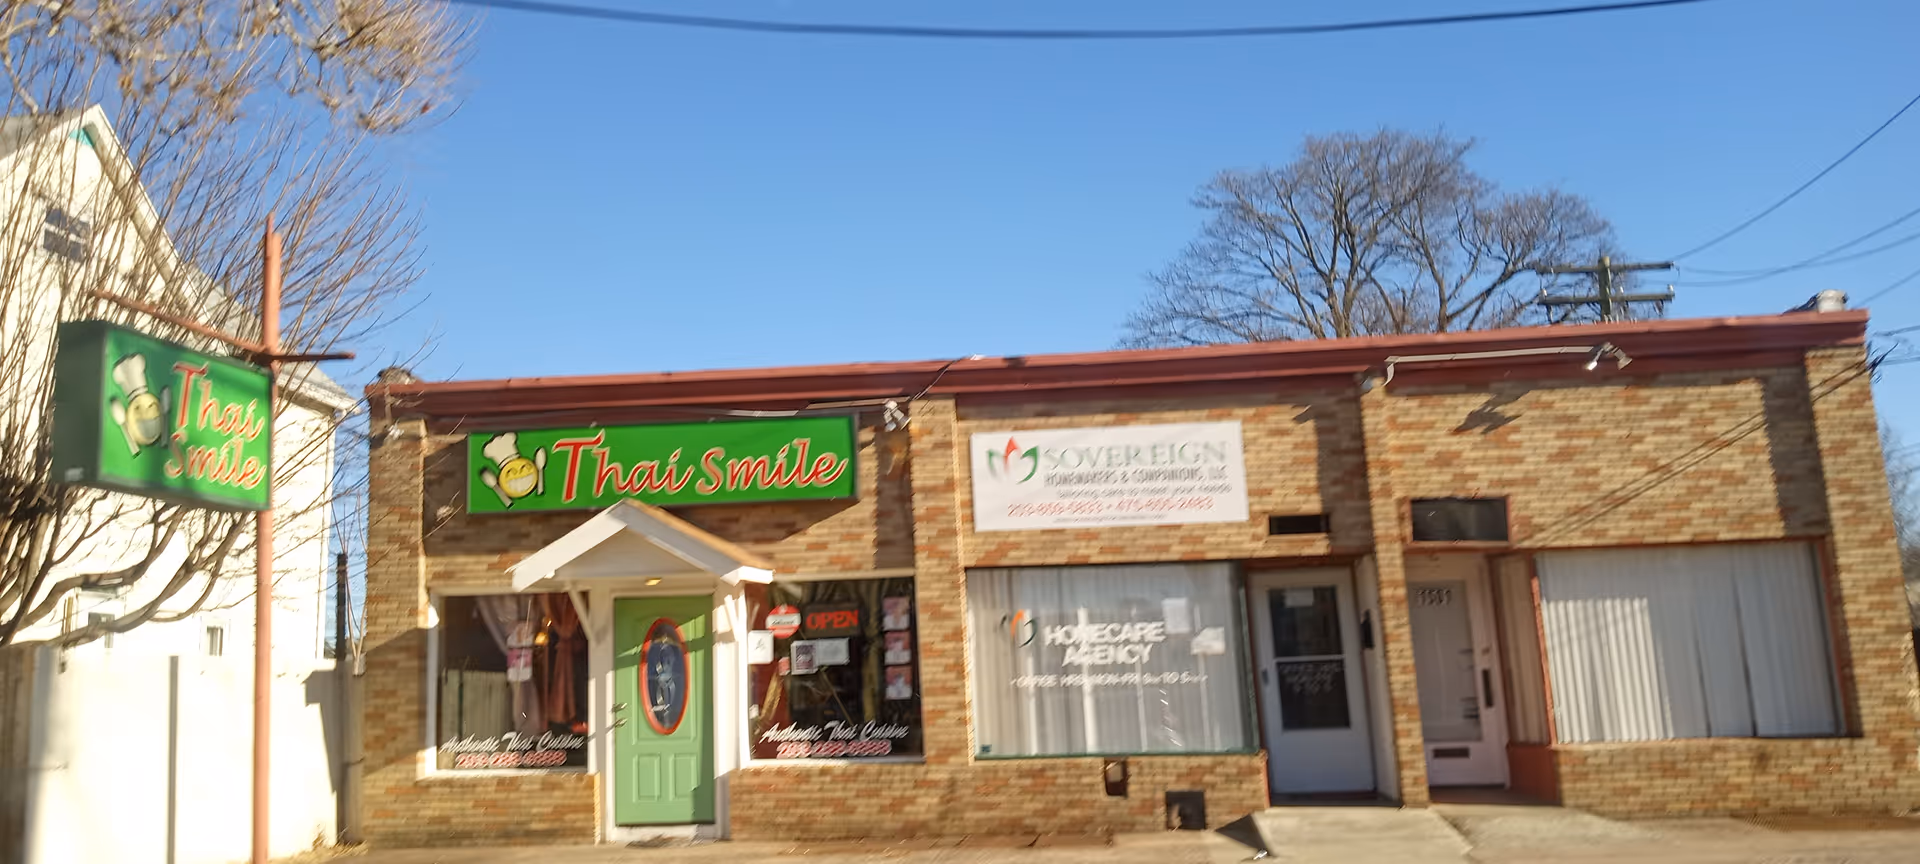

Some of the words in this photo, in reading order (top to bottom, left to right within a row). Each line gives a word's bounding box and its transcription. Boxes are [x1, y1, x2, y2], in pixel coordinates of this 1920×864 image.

[173, 362, 266, 442] Thai
[164, 428, 267, 490] Smile
[552, 429, 695, 503] Thai
[697, 437, 849, 495] Smile
[1043, 440, 1229, 471] SOVEREIGN
[806, 609, 859, 630] OPEN
[1044, 620, 1167, 647] HOMECARE
[1062, 642, 1153, 667] AGENCY
[501, 730, 534, 753] Thai
[824, 719, 858, 742] Thai
